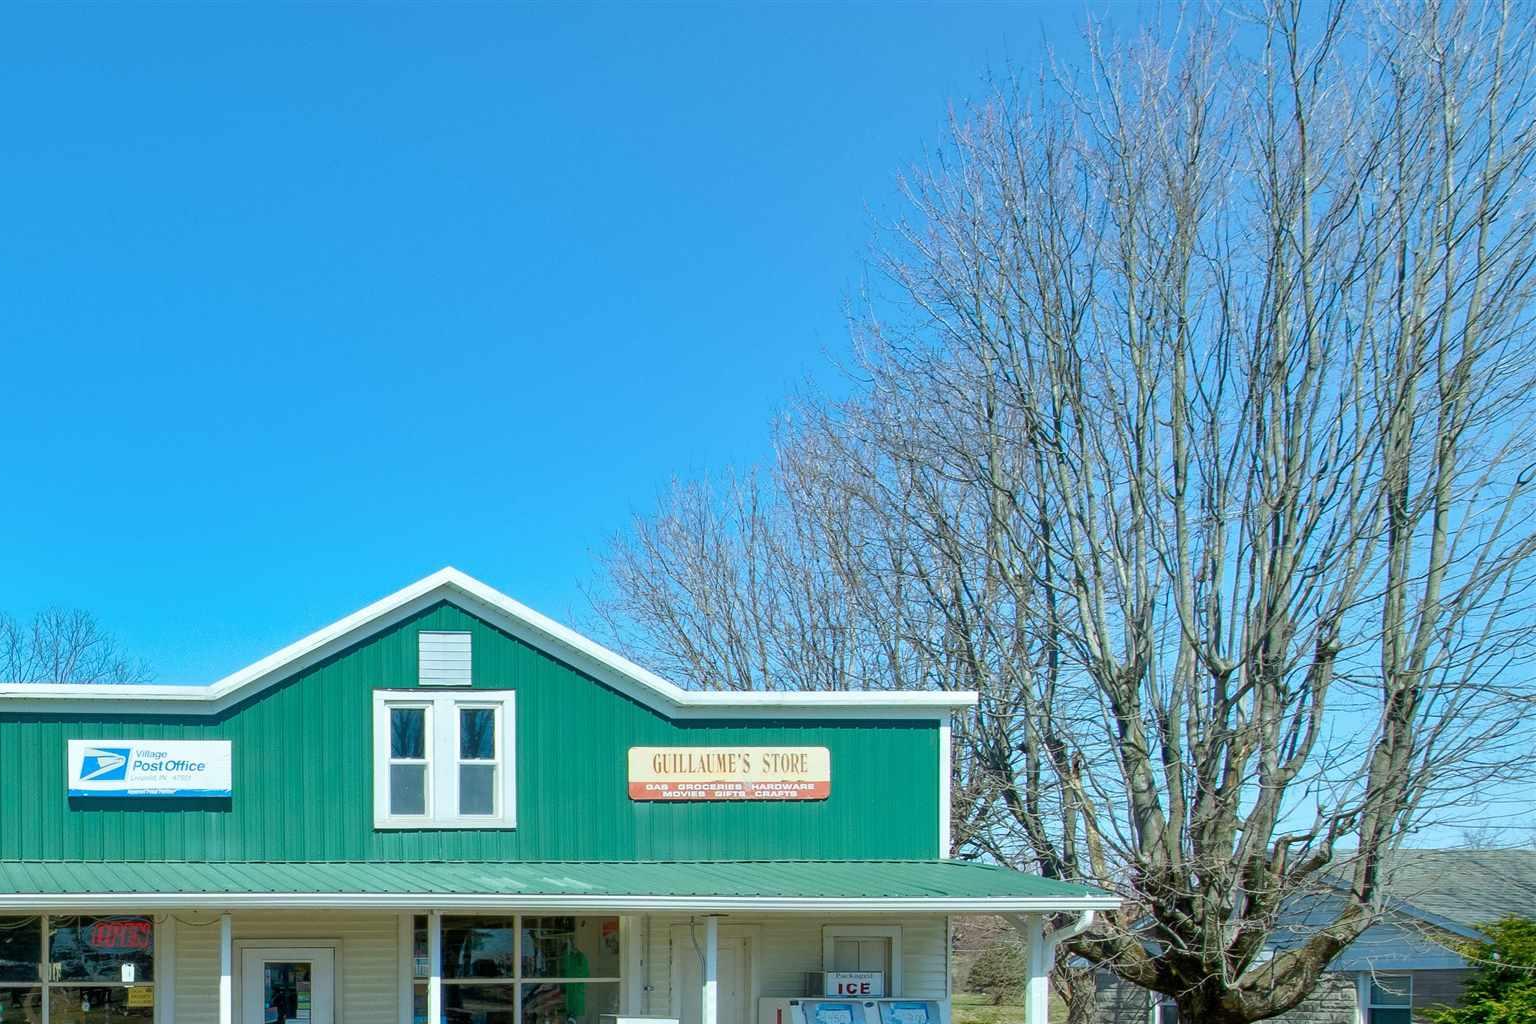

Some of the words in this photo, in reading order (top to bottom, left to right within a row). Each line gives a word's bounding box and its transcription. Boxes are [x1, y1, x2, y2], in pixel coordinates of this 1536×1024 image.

[136, 750, 167, 759] Village
[133, 760, 162, 771] Post
[165, 760, 205, 771] Office
[653, 753, 751, 774] GUILLAUME'S
[762, 753, 808, 774] STORE
[837, 983, 871, 994] ICE
